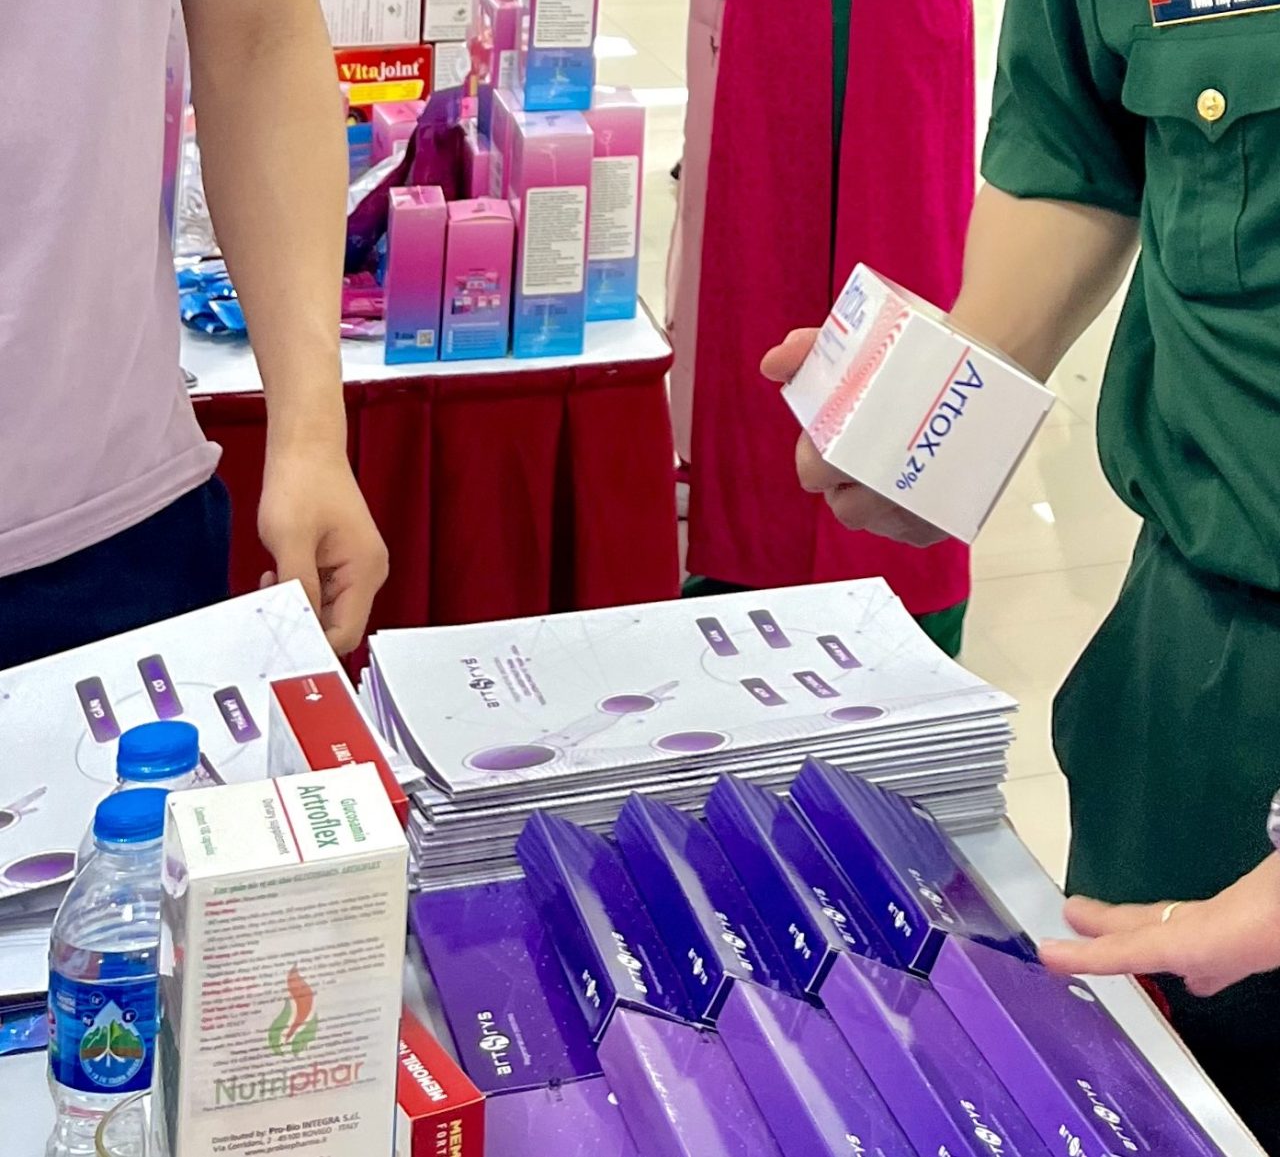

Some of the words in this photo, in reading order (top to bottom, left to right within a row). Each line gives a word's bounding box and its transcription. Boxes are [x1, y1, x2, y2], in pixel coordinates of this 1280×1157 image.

[917, 359, 984, 458] Artox
[896, 456, 926, 490] 2%
[267, 819, 290, 855] supplement
[296, 785, 342, 849] Artroflex
[340, 797, 367, 843] Glucosamin
[215, 1061, 365, 1105] Nutriphar
[401, 1053, 448, 1102] MEMORIL
[211, 1131, 254, 1144] Distributed
[269, 1123, 300, 1135] Pro-Bio
[302, 1115, 340, 1129] INTEGRA
[213, 1144, 226, 1152] Via
